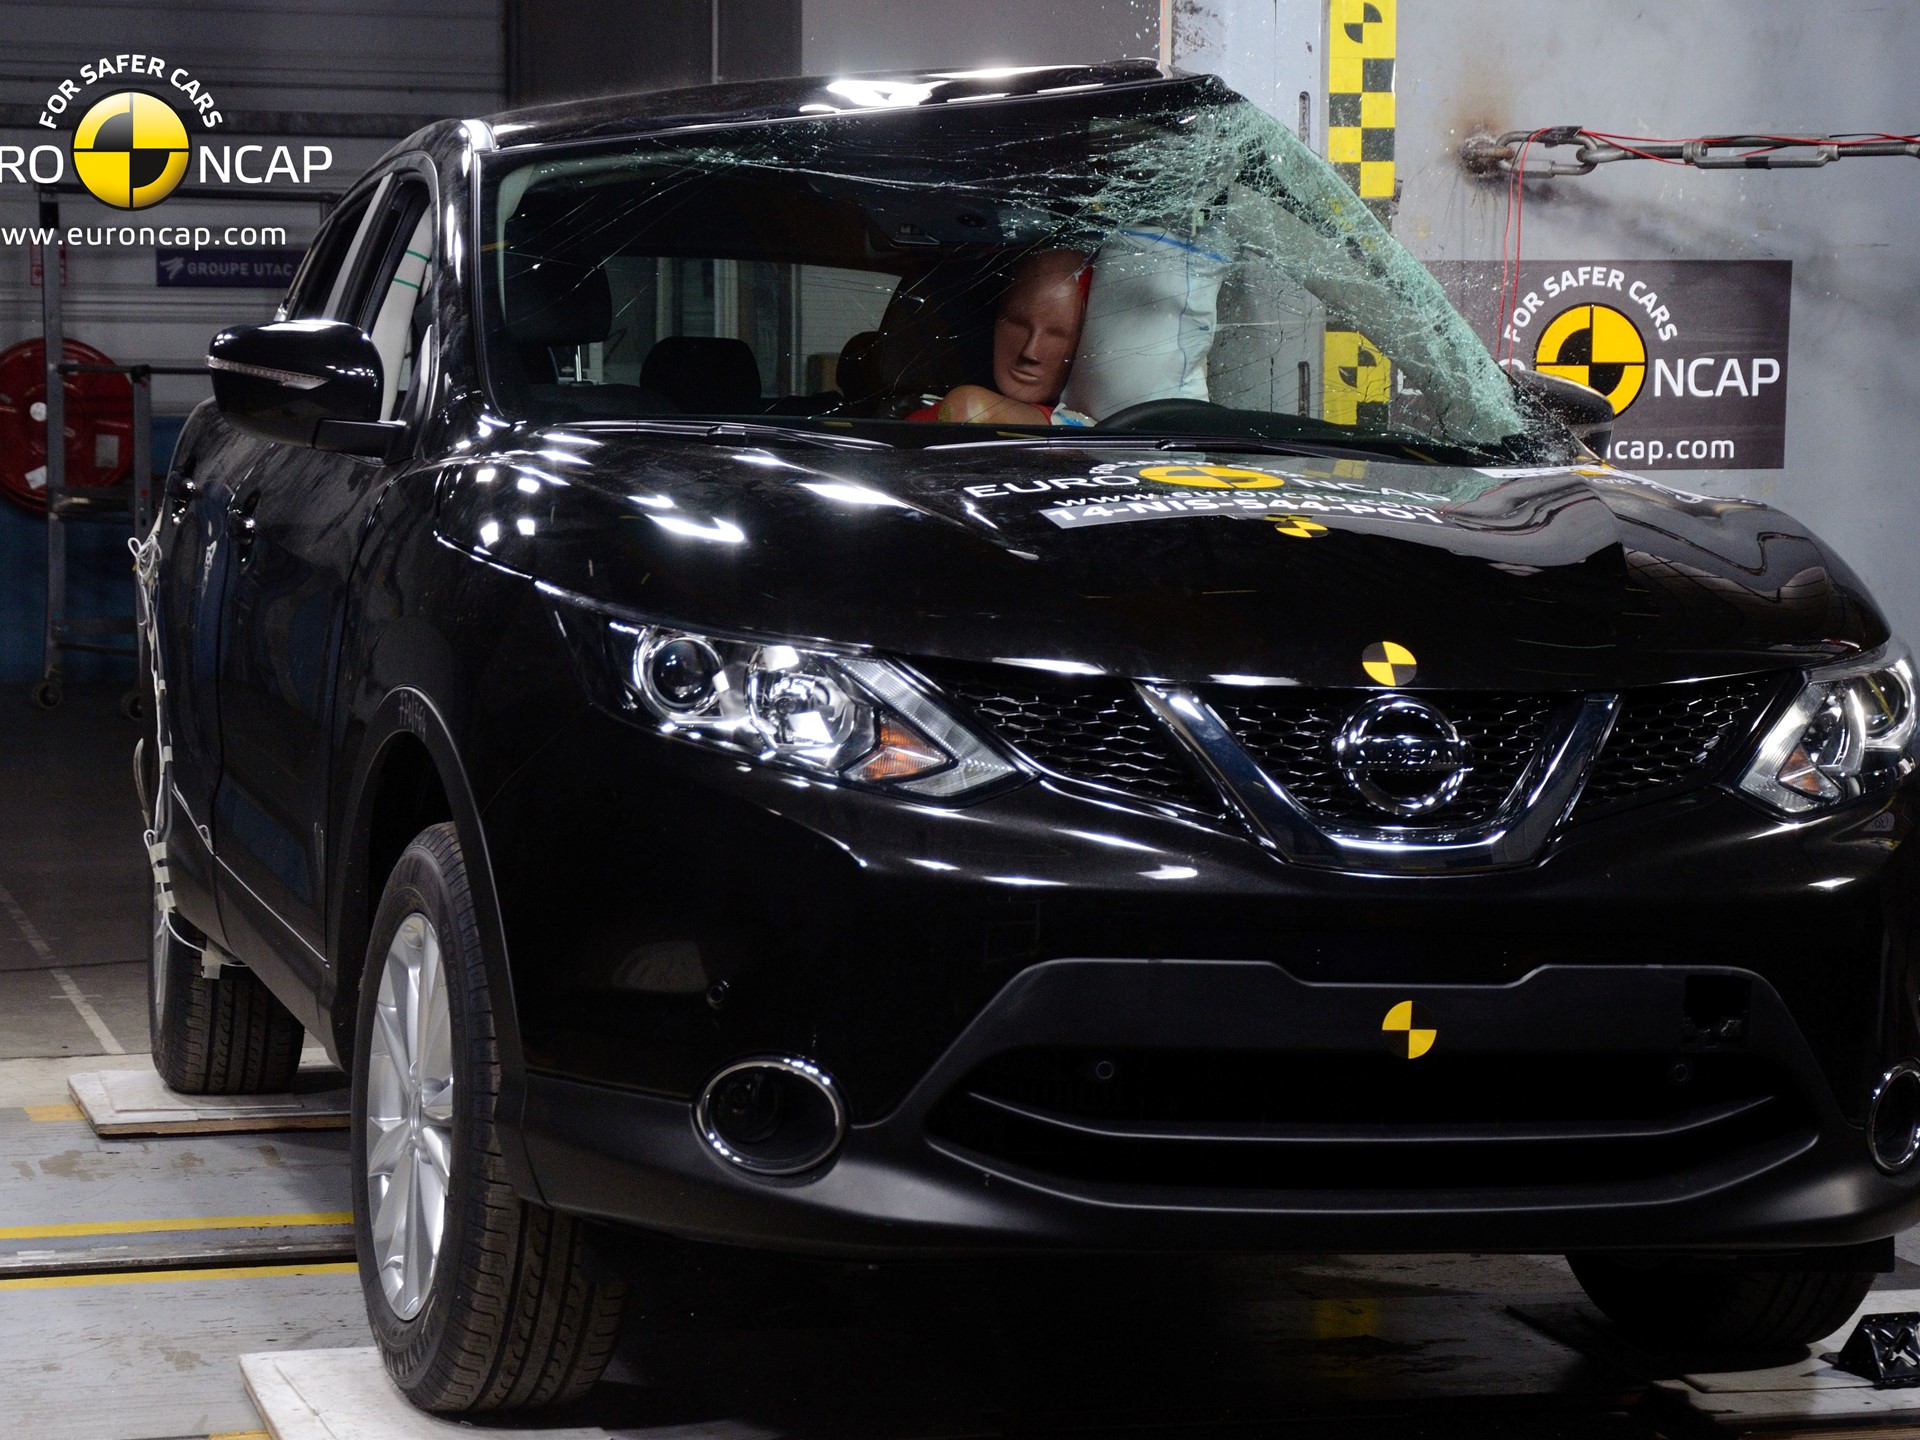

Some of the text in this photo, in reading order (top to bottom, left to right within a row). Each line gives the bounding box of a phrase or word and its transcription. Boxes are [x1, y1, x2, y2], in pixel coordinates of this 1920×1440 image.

[187, 262, 292, 276] GROUPE UTAC
[1503, 266, 1678, 343] FOR SAFER CARS
[1654, 358, 1780, 397] NCAP
[963, 474, 1452, 502] EURO NCAP
[1053, 490, 1437, 515] www.euroncap.com
